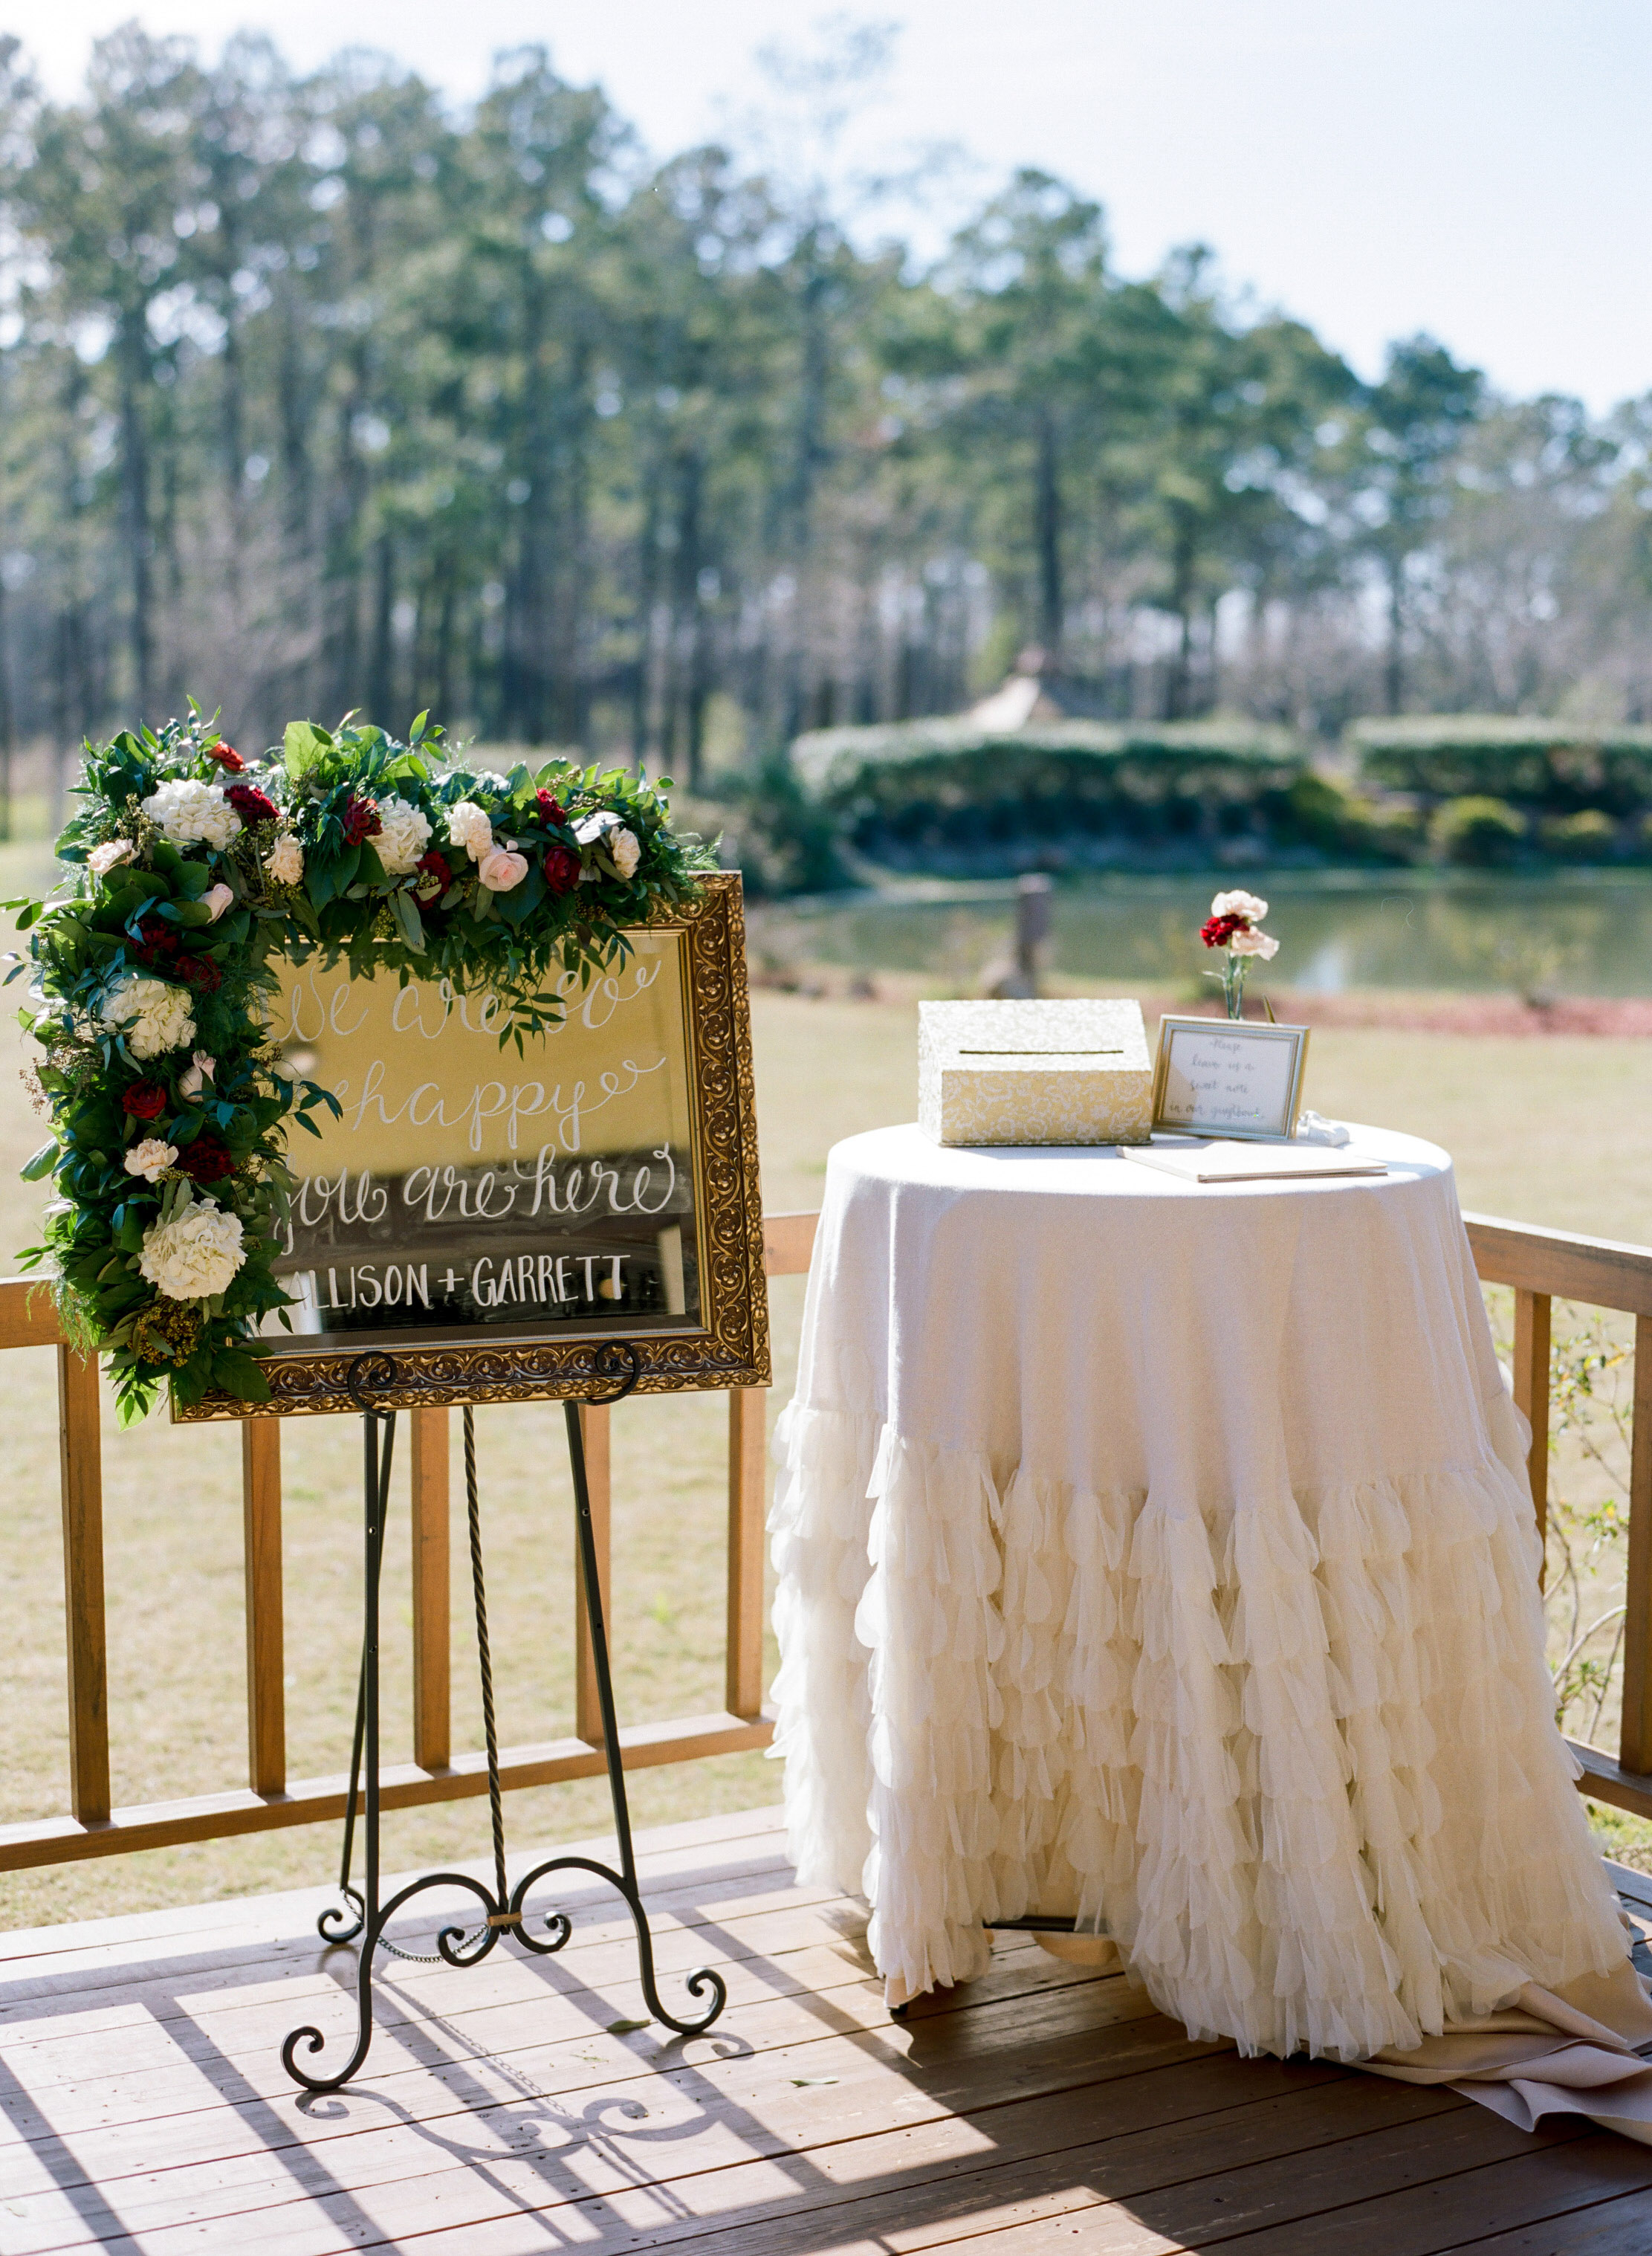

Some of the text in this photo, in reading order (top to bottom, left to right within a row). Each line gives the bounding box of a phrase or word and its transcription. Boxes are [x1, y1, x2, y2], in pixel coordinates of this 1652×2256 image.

[256, 960, 662, 1041] We are so
[306, 1056, 667, 1152] happy
[404, 1166, 519, 1218] are
[514, 1142, 675, 1216] here
[288, 1255, 631, 1310] ALLISON + GARRETT
